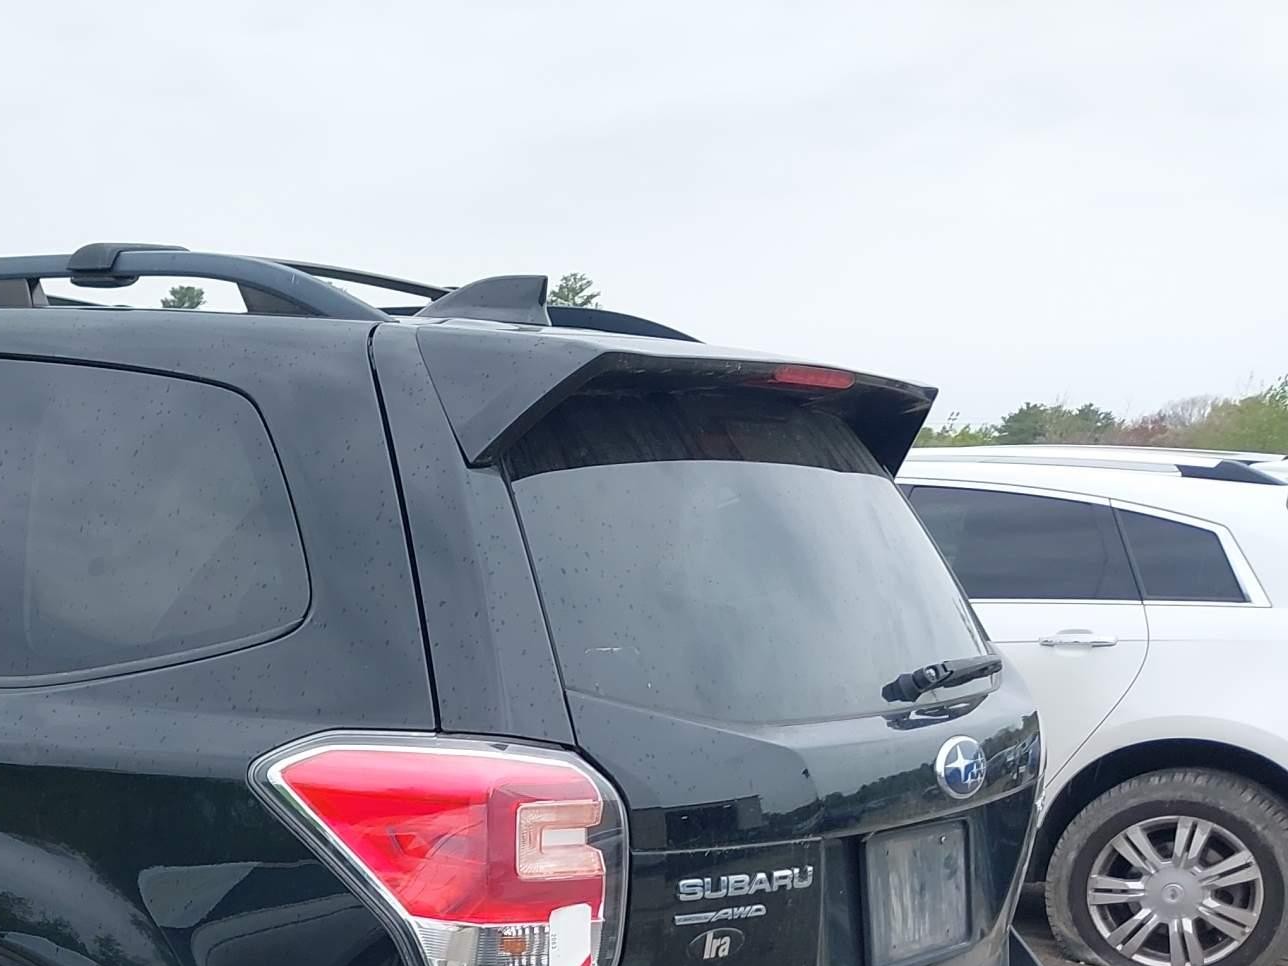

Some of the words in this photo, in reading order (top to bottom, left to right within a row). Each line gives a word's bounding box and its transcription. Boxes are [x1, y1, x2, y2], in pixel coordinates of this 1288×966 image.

[678, 865, 814, 902] SUBARU
[710, 904, 767, 922] AWD
[702, 929, 732, 961] Ira
